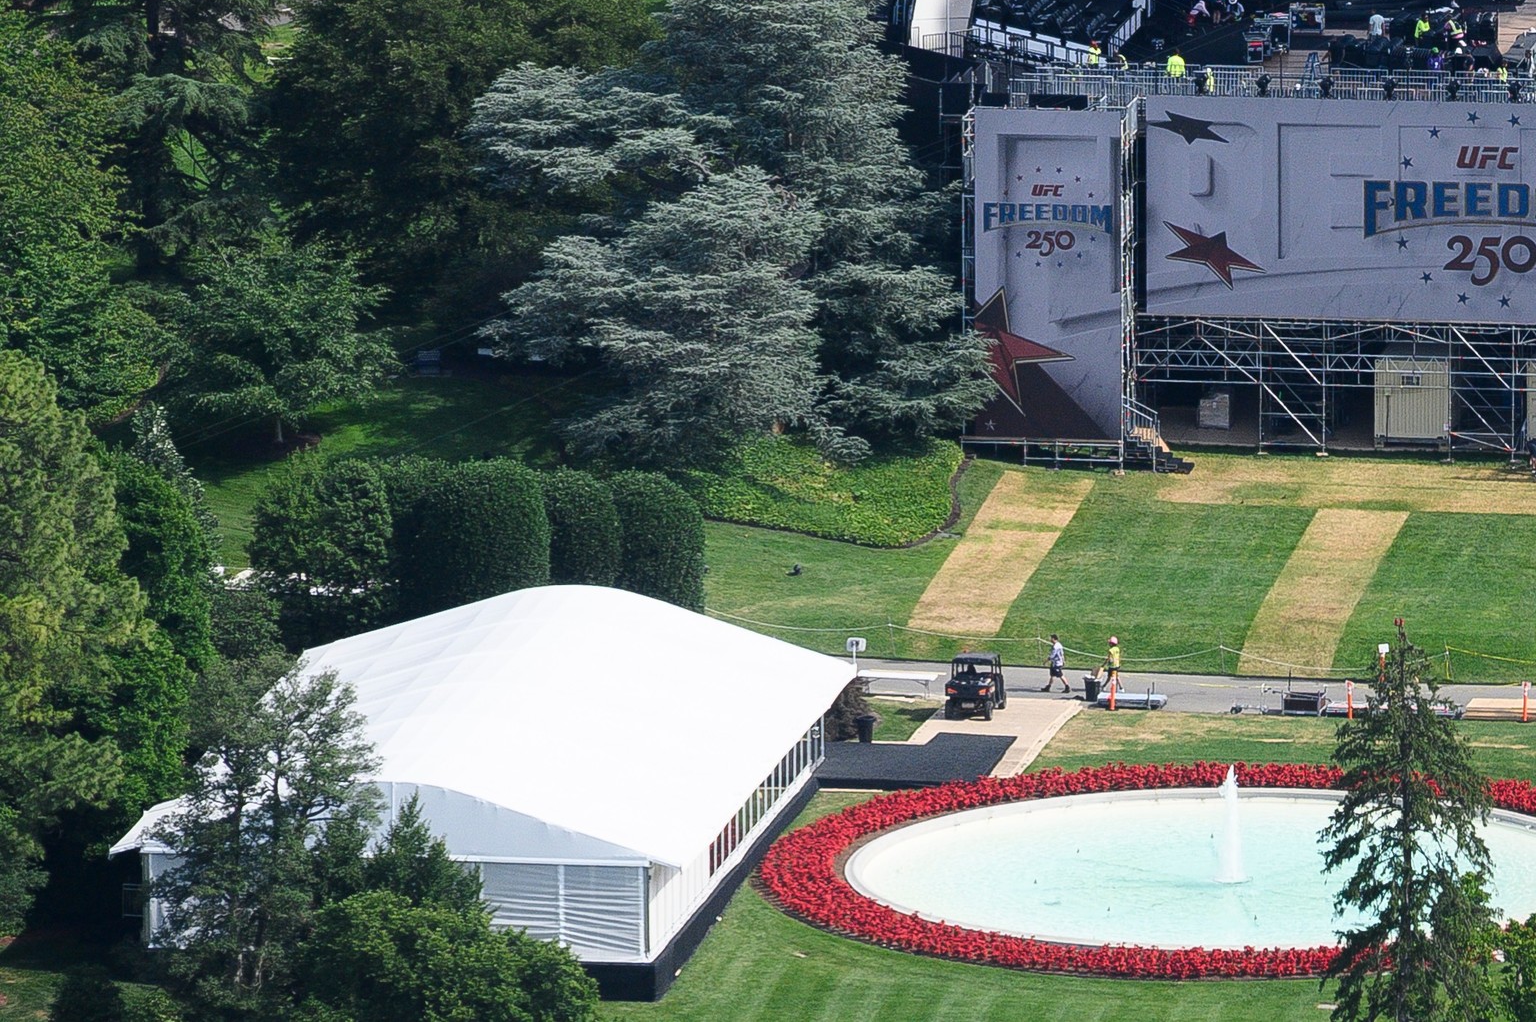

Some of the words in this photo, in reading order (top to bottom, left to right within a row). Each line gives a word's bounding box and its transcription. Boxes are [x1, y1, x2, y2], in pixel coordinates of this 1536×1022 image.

[1456, 146, 1518, 170] UFC
[1031, 184, 1064, 197] UFC
[983, 202, 1113, 234] FREEDOM
[1025, 230, 1076, 257] 250
